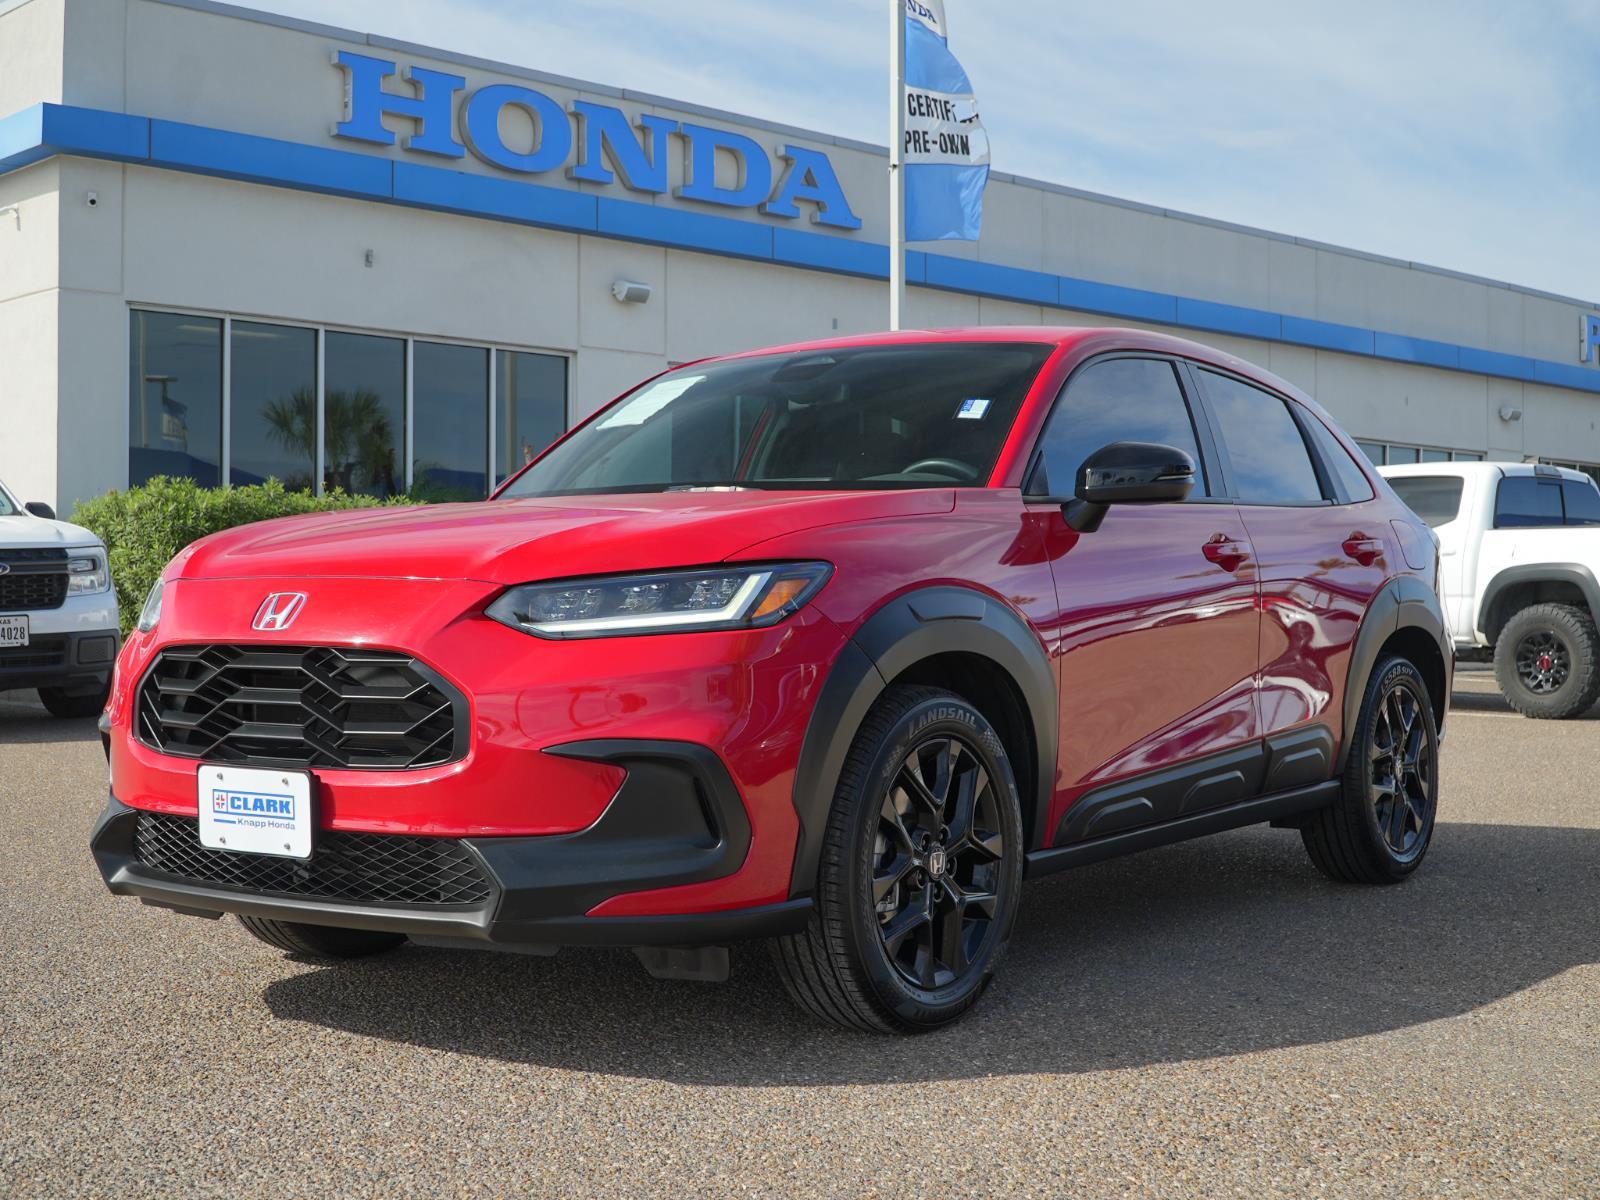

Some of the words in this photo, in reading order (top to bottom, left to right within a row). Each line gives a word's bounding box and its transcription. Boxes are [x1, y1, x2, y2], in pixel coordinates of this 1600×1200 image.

[907, 0, 937, 24] NDA
[907, 93, 979, 123] CERTIF
[331, 50, 862, 230] HONDA
[908, 707, 977, 739] LANDSAIL
[230, 796, 291, 814] CLARK
[237, 818, 267, 828] Knapp
[268, 820, 296, 830] Honda
